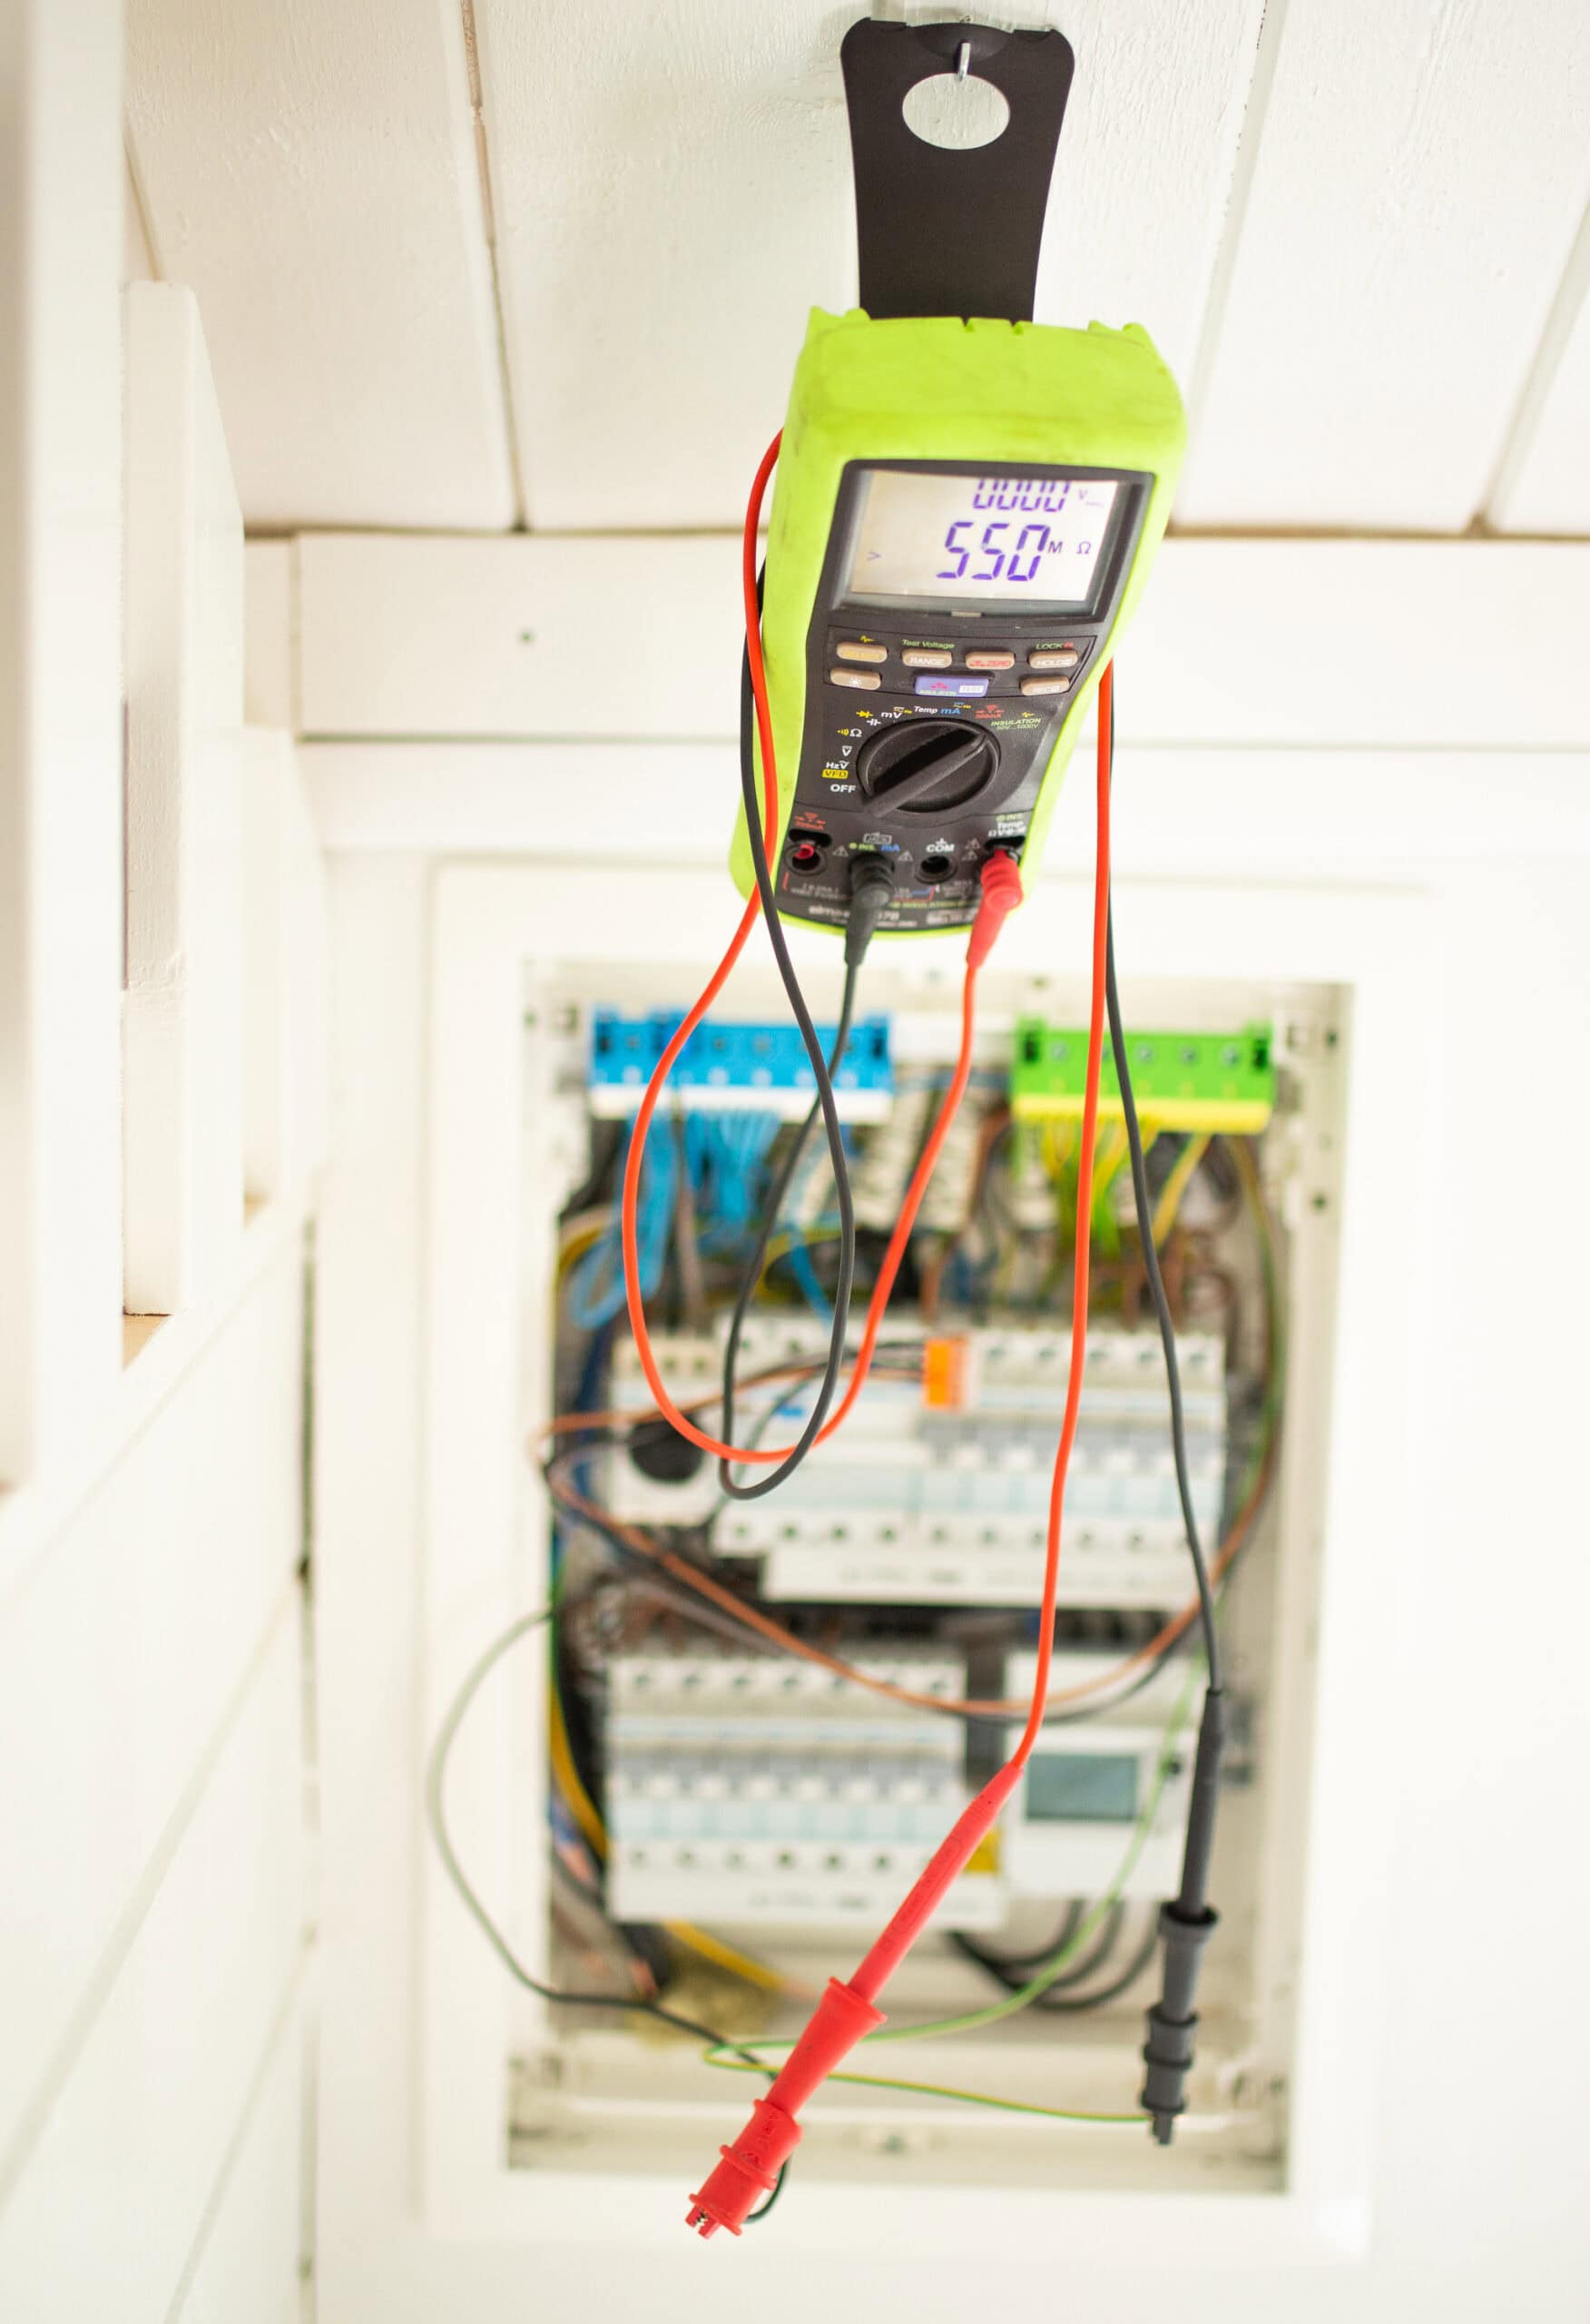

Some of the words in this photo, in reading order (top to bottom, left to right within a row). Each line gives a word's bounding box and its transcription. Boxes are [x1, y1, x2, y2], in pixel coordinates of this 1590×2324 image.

[937, 521, 1051, 581] 550
[902, 638, 920, 646] Test
[922, 640, 956, 650] Voltage
[910, 656, 946, 665] RANGE
[914, 705, 938, 714] Temp
[880, 711, 903, 719] mV
[991, 718, 1042, 727] INSULATION
[829, 783, 857, 793] OFF
[926, 843, 956, 853] COM
